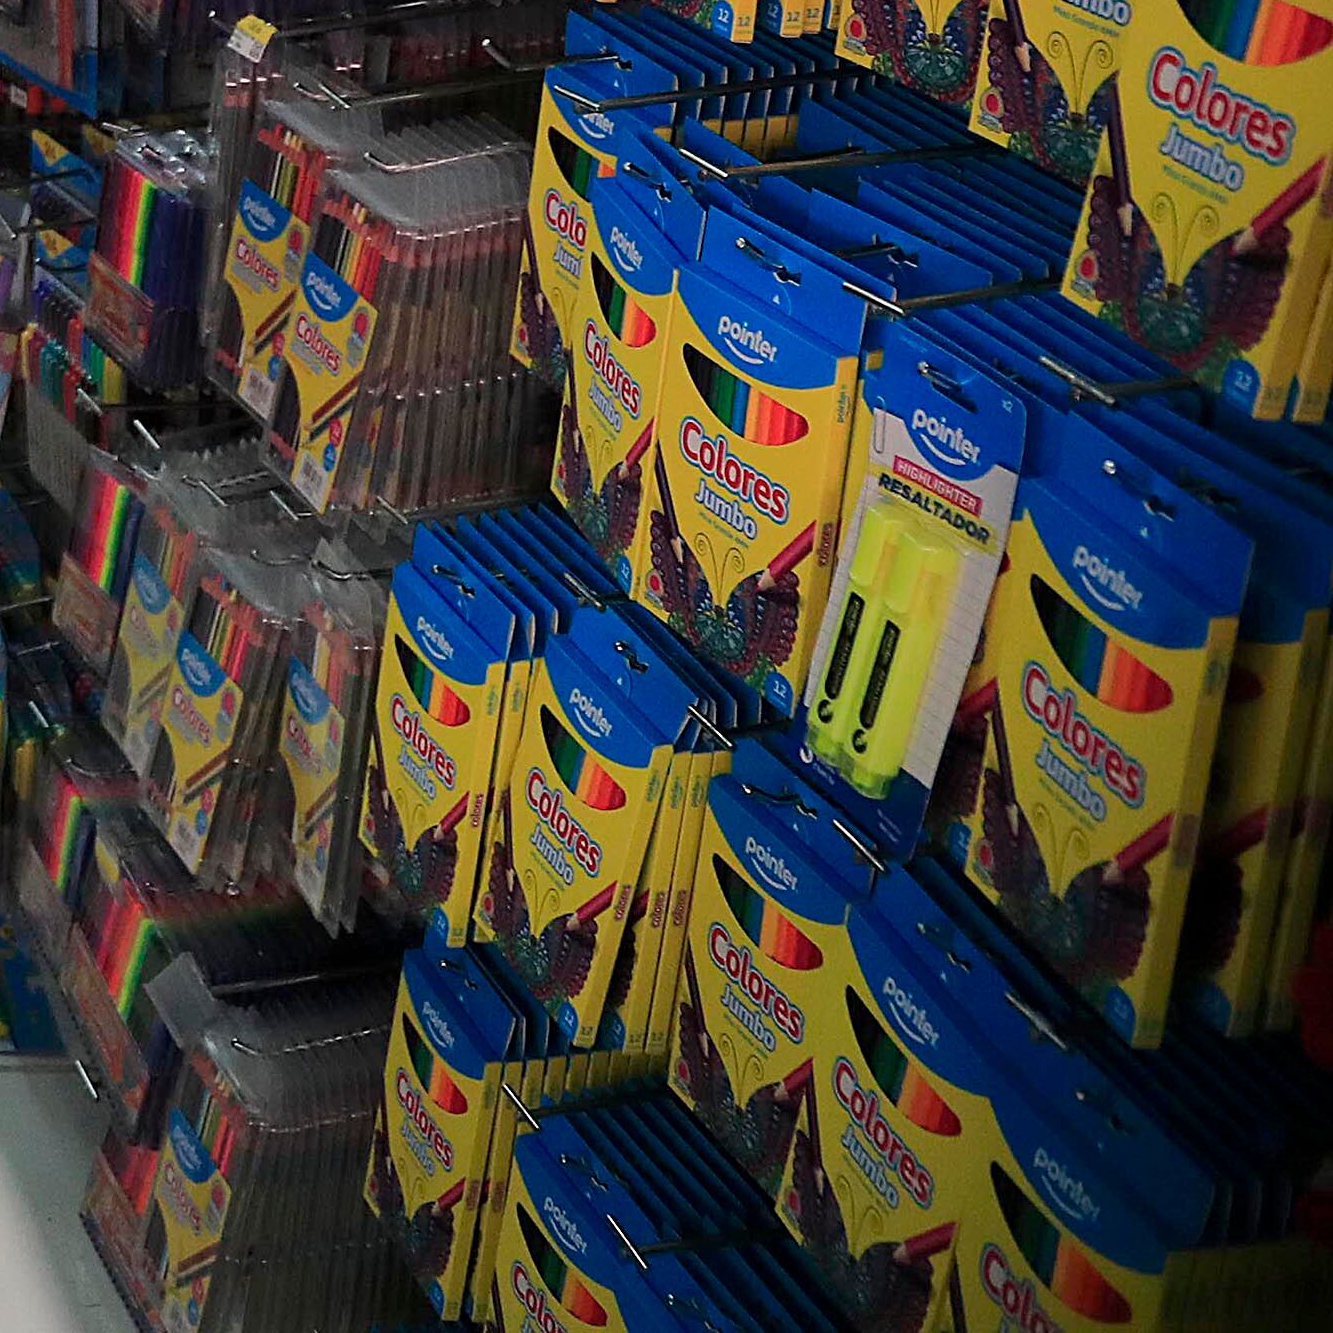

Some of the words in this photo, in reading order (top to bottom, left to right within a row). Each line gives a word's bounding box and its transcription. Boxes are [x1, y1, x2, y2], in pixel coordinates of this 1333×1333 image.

[1148, 47, 1295, 164] Colores
[1159, 124, 1245, 193] Jumbo
[544, 188, 587, 251] Colo
[610, 225, 644, 272] pointer
[235, 238, 280, 288] Colores
[553, 242, 581, 280] Jum
[296, 312, 342, 376] Colores
[584, 320, 641, 418] Colores
[717, 313, 778, 363] pointer
[588, 380, 623, 433] Jumbo
[912, 407, 981, 465] pointer
[680, 418, 789, 523] Colores
[895, 459, 980, 515] HIGHLIGHTER
[694, 476, 758, 540] Jumbo
[876, 473, 991, 546] RESALTADOR
[1073, 544, 1143, 610] pointer
[416, 616, 454, 658] pointer
[172, 685, 214, 748] Colores
[391, 695, 456, 791] Colores
[568, 687, 613, 738] pointer
[1020, 662, 1146, 808] Colores
[398, 750, 438, 799] Jumbo
[1035, 742, 1107, 822] Jumbo
[526, 768, 602, 876] Colores
[529, 827, 574, 884] Jumbo
[746, 834, 799, 891] pointer
[708, 922, 805, 1043] Colores
[882, 975, 940, 1050] pointer
[422, 1001, 456, 1049] pointer
[720, 984, 776, 1051] Jumbo
[395, 1066, 453, 1171] Colores
[400, 1123, 435, 1175] Jumbo
[833, 1056, 933, 1210] Colores
[841, 1128, 900, 1211] Jumbo
[1034, 1147, 1099, 1223] pointer
[543, 1196, 588, 1257] pointer
[512, 1260, 564, 1333] Colo
[981, 1243, 1057, 1333] Colo
